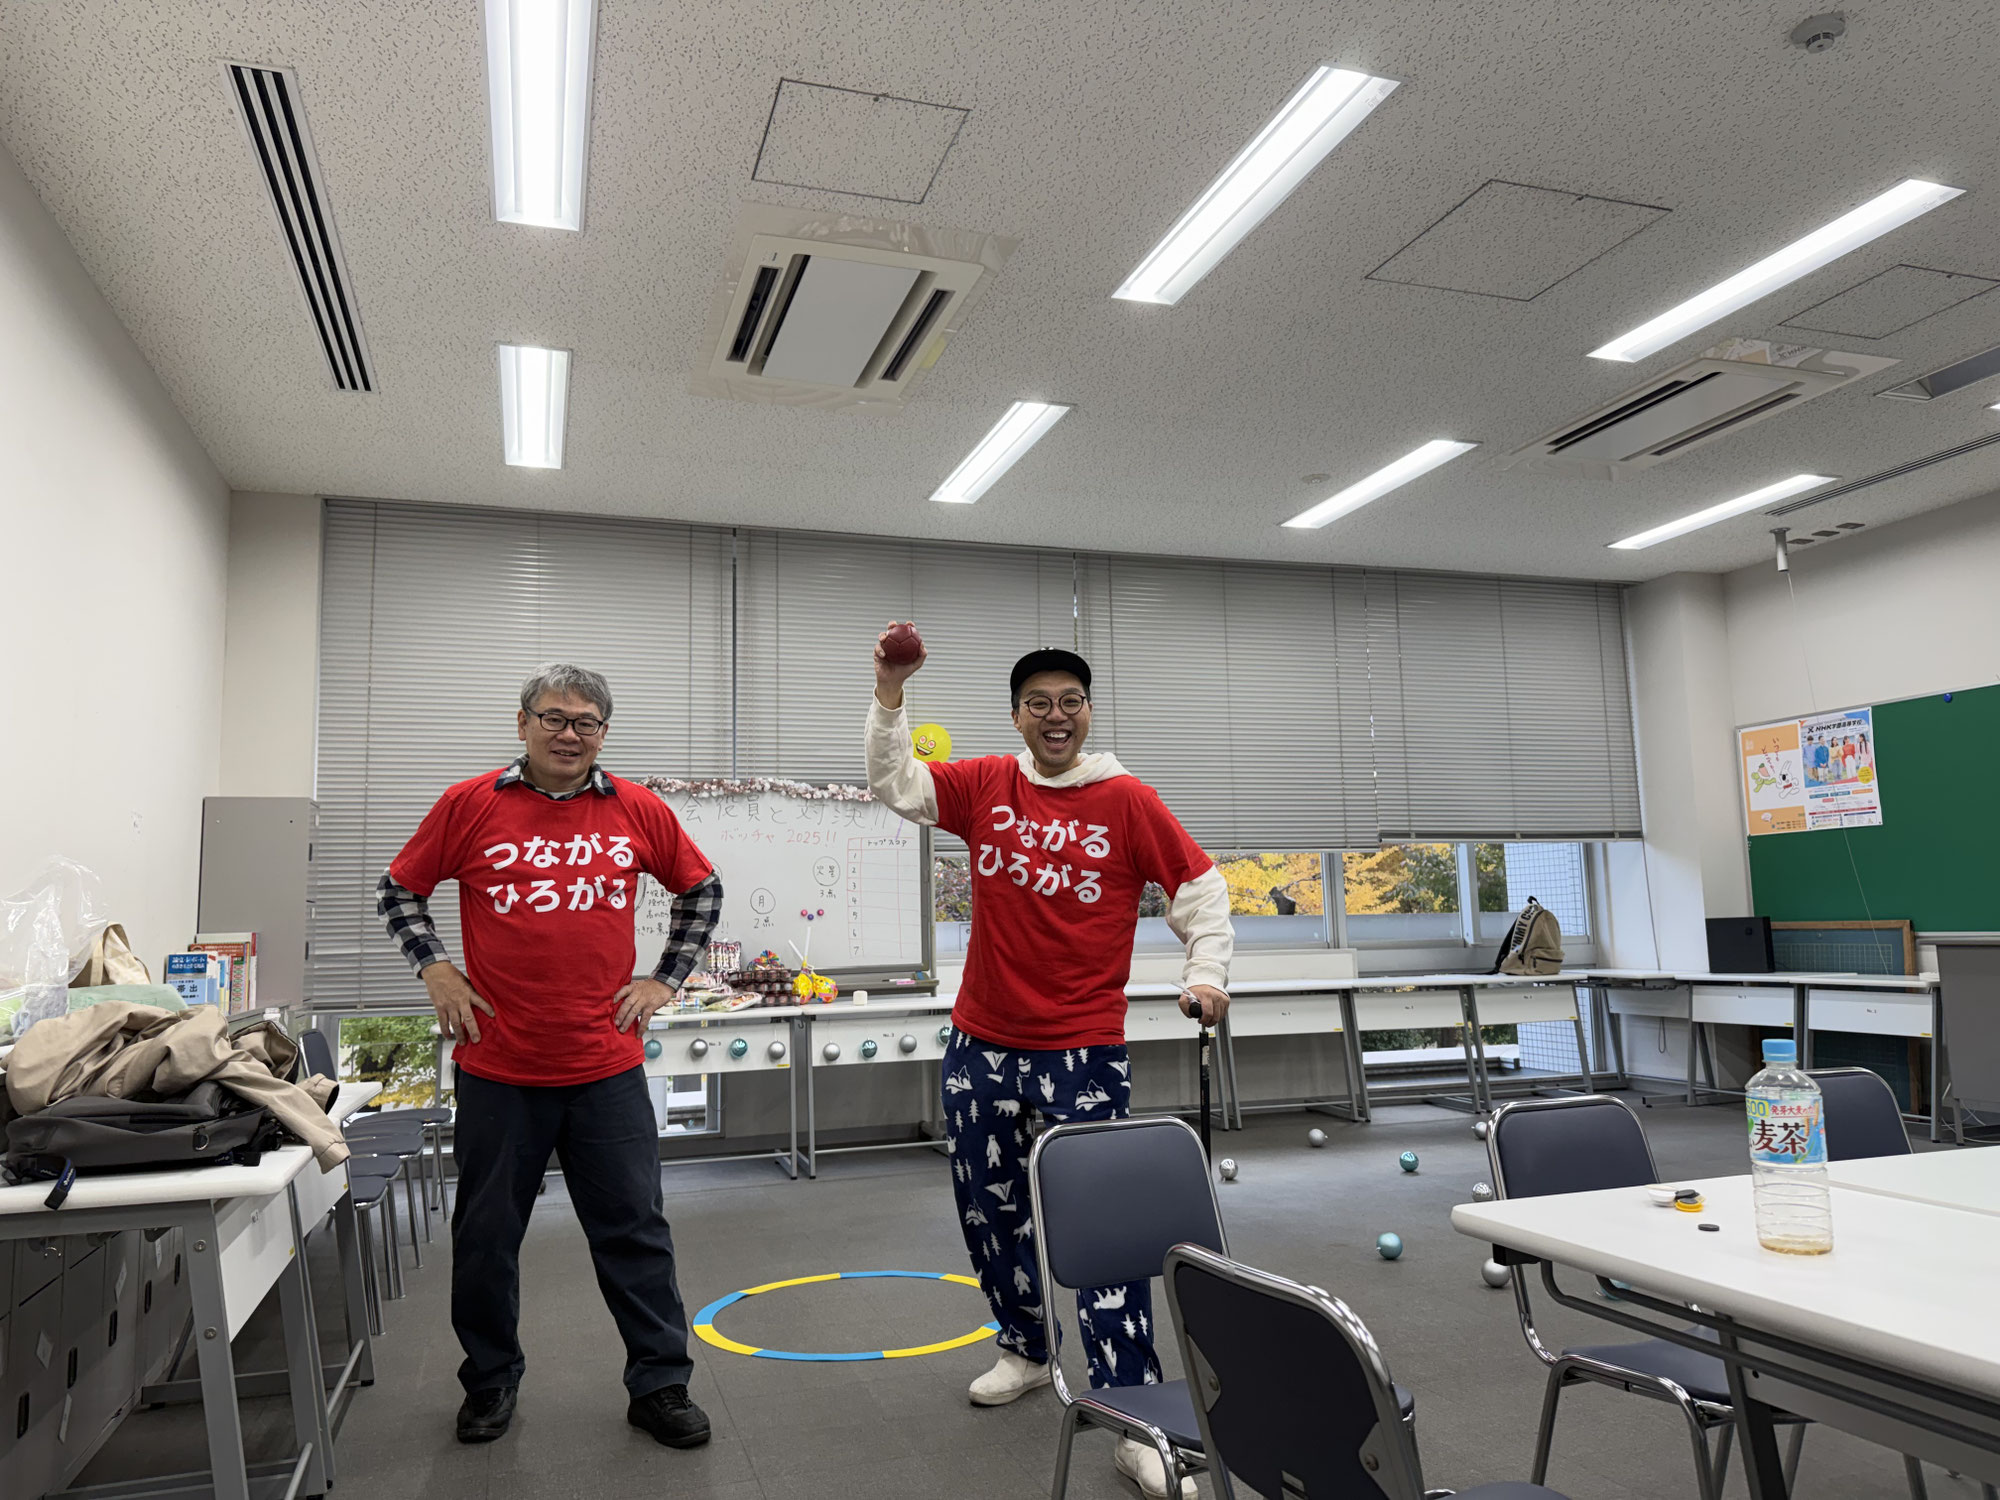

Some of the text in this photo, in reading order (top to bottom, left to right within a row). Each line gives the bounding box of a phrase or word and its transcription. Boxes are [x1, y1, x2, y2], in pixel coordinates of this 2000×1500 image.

[992, 805, 1111, 858] つながる
[484, 832, 634, 871] つながる
[851, 866, 857, 874] 2
[977, 843, 1102, 904] ひろがる
[486, 874, 627, 914] ひろがる
[853, 946, 860, 955] 7
[1754, 1119, 1808, 1155] 麦茶
